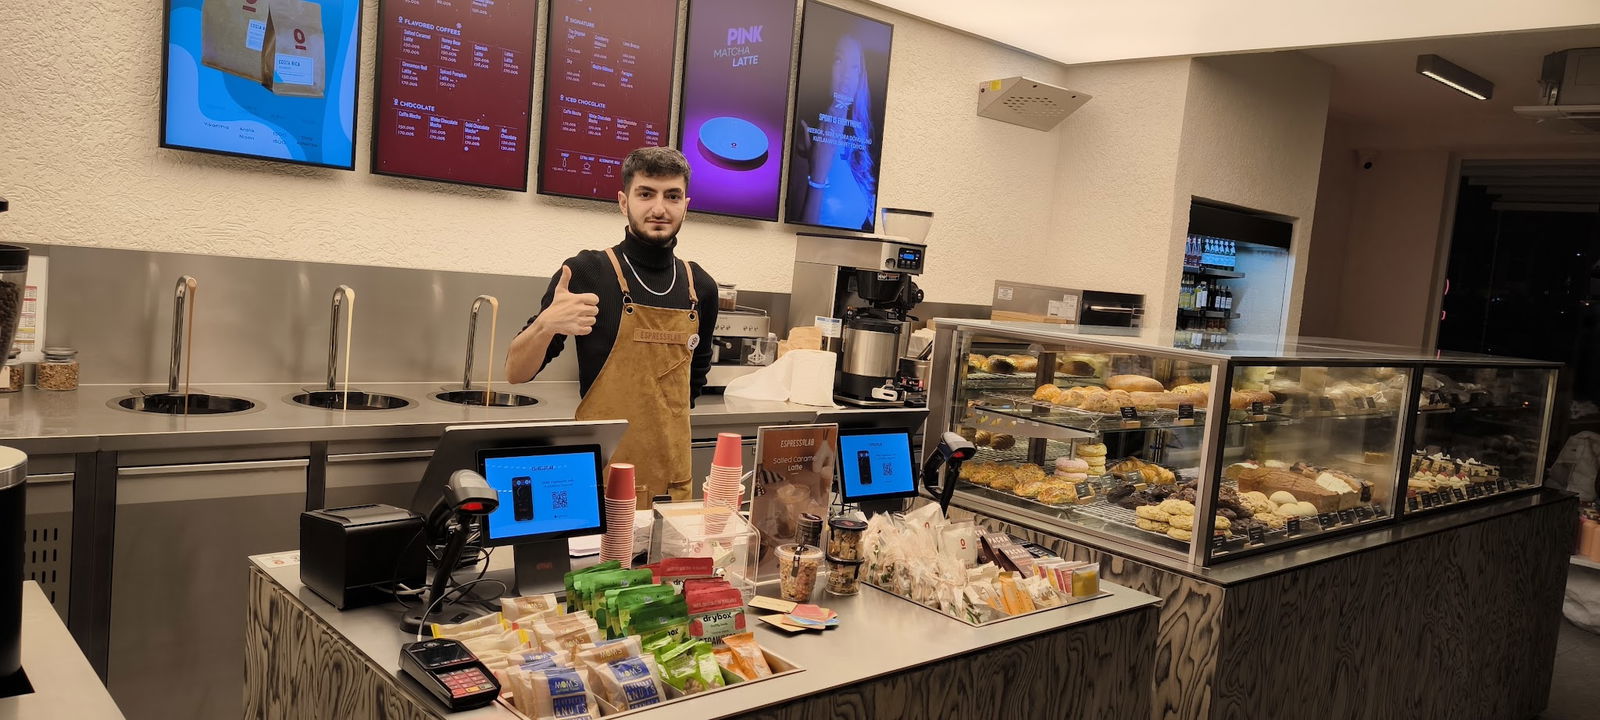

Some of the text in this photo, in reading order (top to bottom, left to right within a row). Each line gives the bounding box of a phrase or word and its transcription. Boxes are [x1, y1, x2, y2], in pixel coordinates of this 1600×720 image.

[404, 18, 435, 30] FLAVORED
[727, 25, 763, 46] PINK
[713, 46, 750, 58] MATCHA
[732, 55, 759, 67] LATTE
[400, 100, 435, 111] CHOCOLATE
[578, 99, 606, 109] CHOCOLATE
[703, 612, 732, 622] drybox
[562, 704, 587, 717] NUTS
